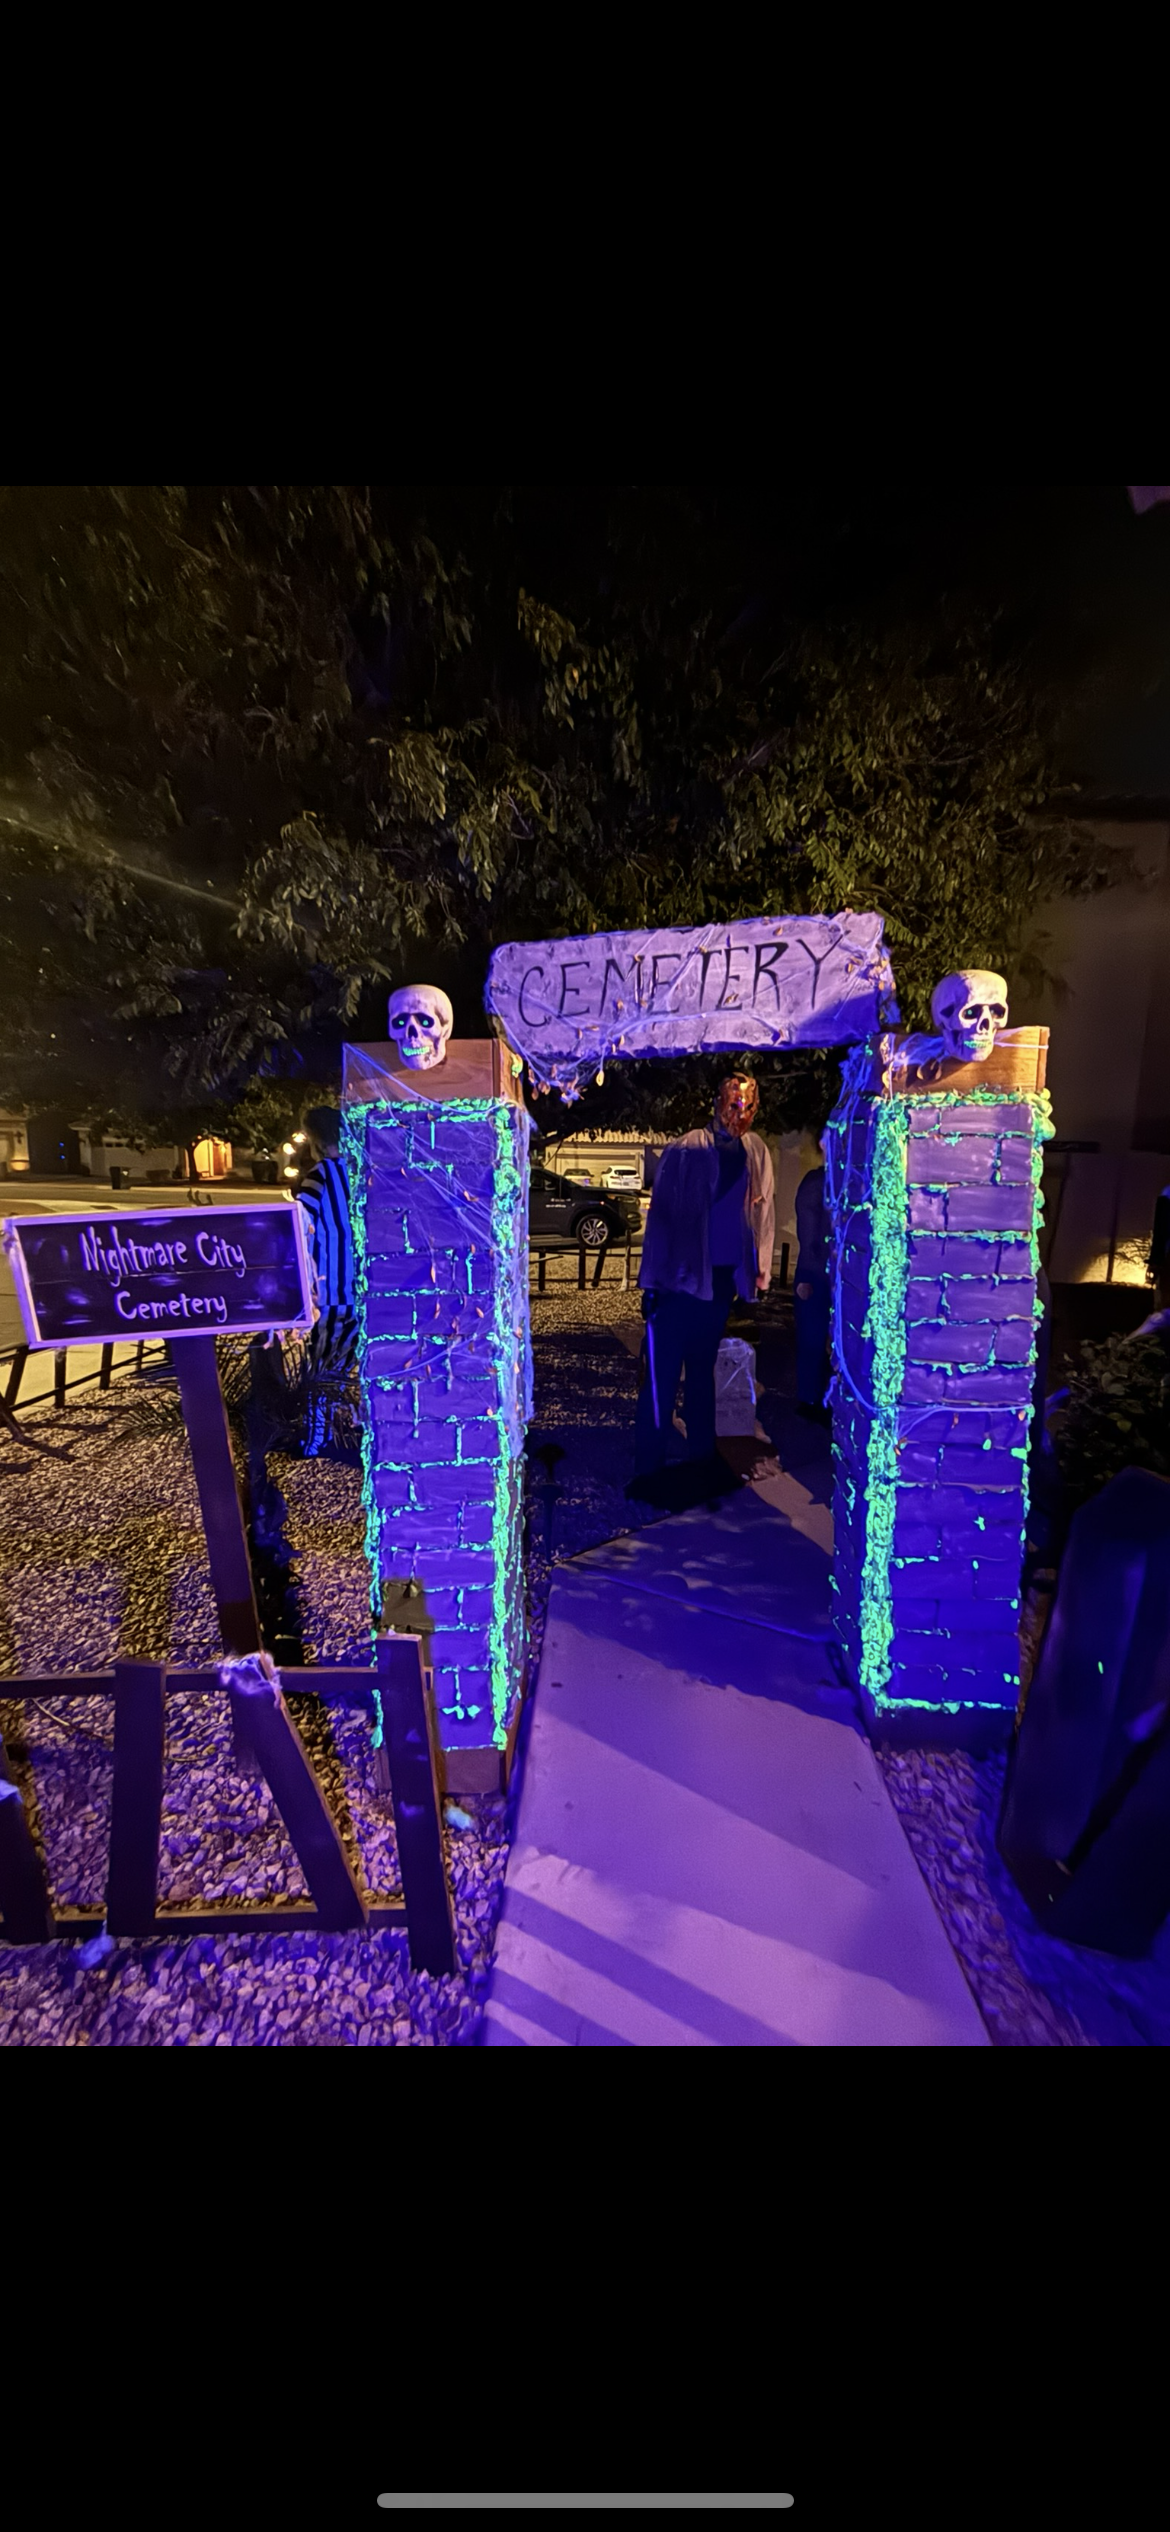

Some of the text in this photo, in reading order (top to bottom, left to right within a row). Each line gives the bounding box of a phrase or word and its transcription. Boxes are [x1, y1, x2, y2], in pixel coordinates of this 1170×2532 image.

[519, 931, 848, 1028] CEMETERY
[80, 1226, 247, 1287] Nightmare City
[115, 1291, 228, 1323] Cemetery
